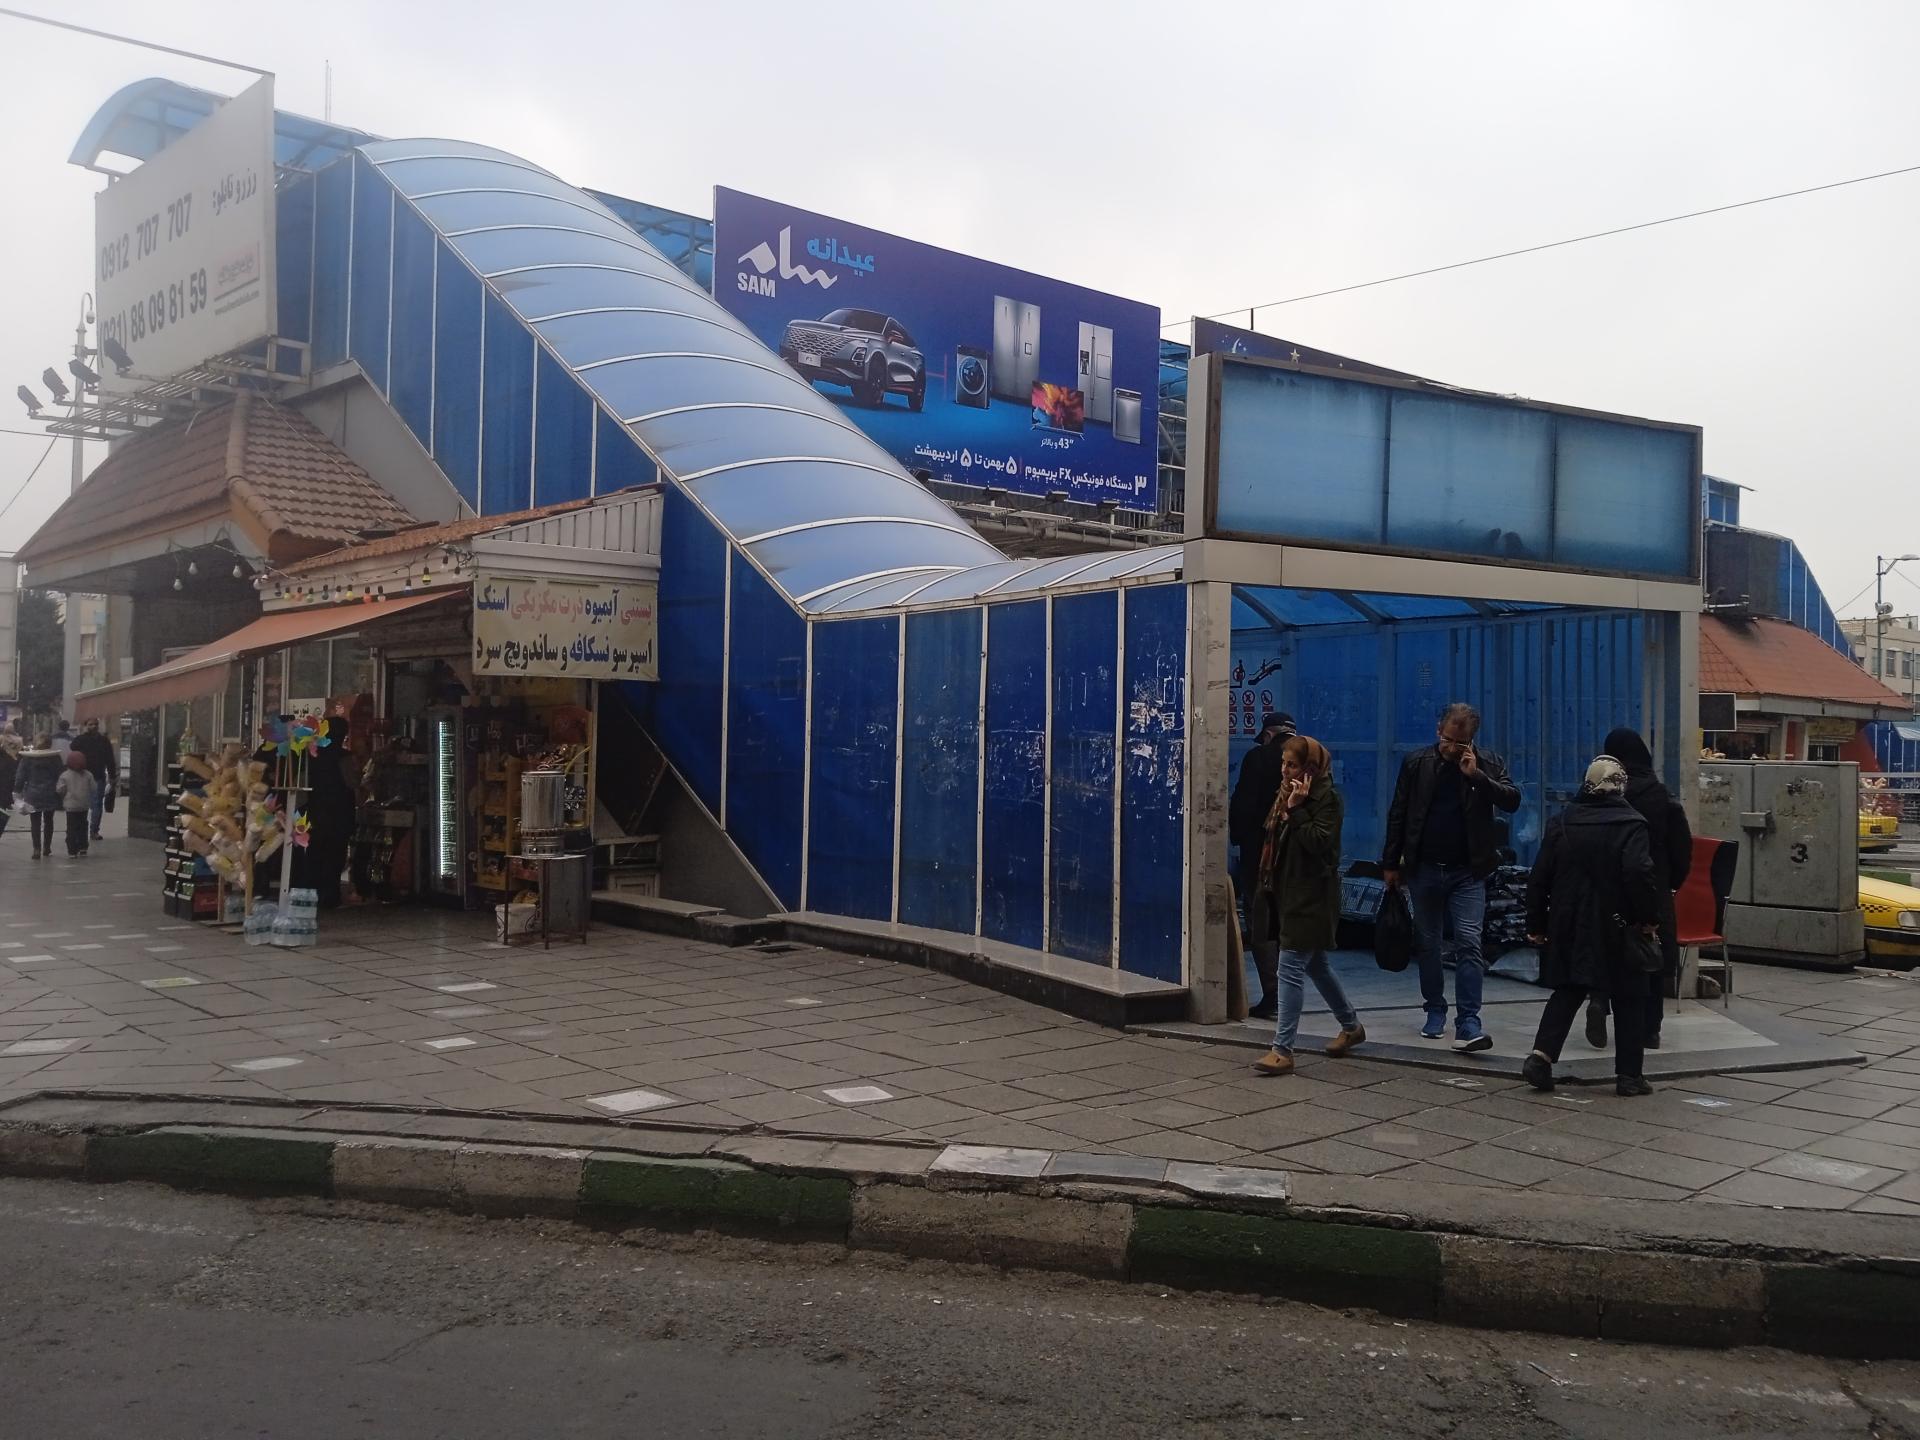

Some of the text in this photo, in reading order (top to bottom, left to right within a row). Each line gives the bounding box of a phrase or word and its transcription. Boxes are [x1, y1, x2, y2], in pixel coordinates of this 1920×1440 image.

[235, 168, 257, 204] رزرو
[101, 192, 192, 282] 0912 707 707
[806, 238, 875, 277] عیدانه
[737, 272, 776, 298] SAM
[130, 301, 146, 343] 88
[149, 290, 165, 333] 09
[169, 279, 184, 324] 81
[190, 267, 207, 314] 59
[914, 443, 1147, 495] ۳ دستگاه فونیکس FX پریمیوم ۵ بهمن تا ۵ اردیبهشت
[476, 584, 652, 625] بستنی آبمیوه ذرت مکزیکی اسنک
[476, 636, 501, 670] سرد
[503, 633, 559, 670] ساندویچ
[560, 645, 568, 671] و
[569, 632, 610, 663] نسکافه
[1790, 842, 1809, 864] 3
